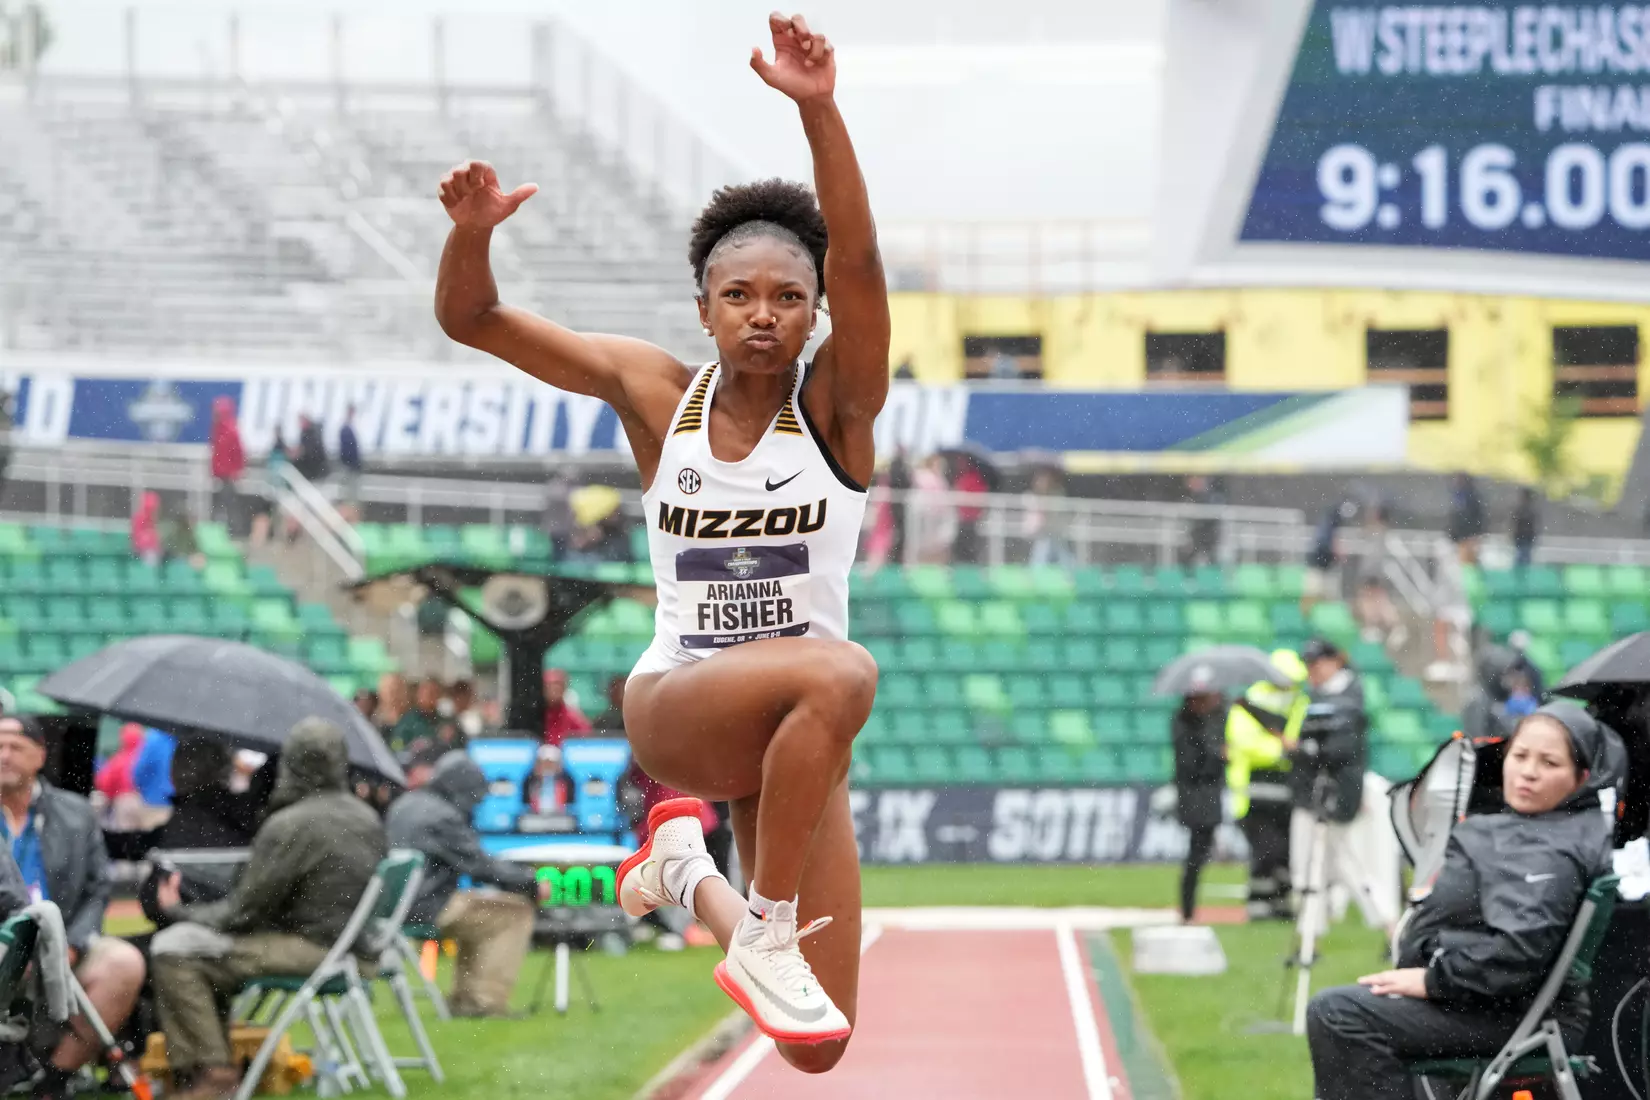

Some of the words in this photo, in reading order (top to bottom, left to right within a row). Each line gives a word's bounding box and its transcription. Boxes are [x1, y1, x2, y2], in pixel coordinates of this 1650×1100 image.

[1330, 7, 1377, 75] W
[1316, 143, 1650, 231] 9:16.00
[243, 375, 606, 456] UNIVERSITY
[679, 470, 700, 494] SEC
[658, 497, 828, 539] MIZZOU
[706, 580, 783, 601] ARIANNA
[697, 598, 793, 631] FISHER
